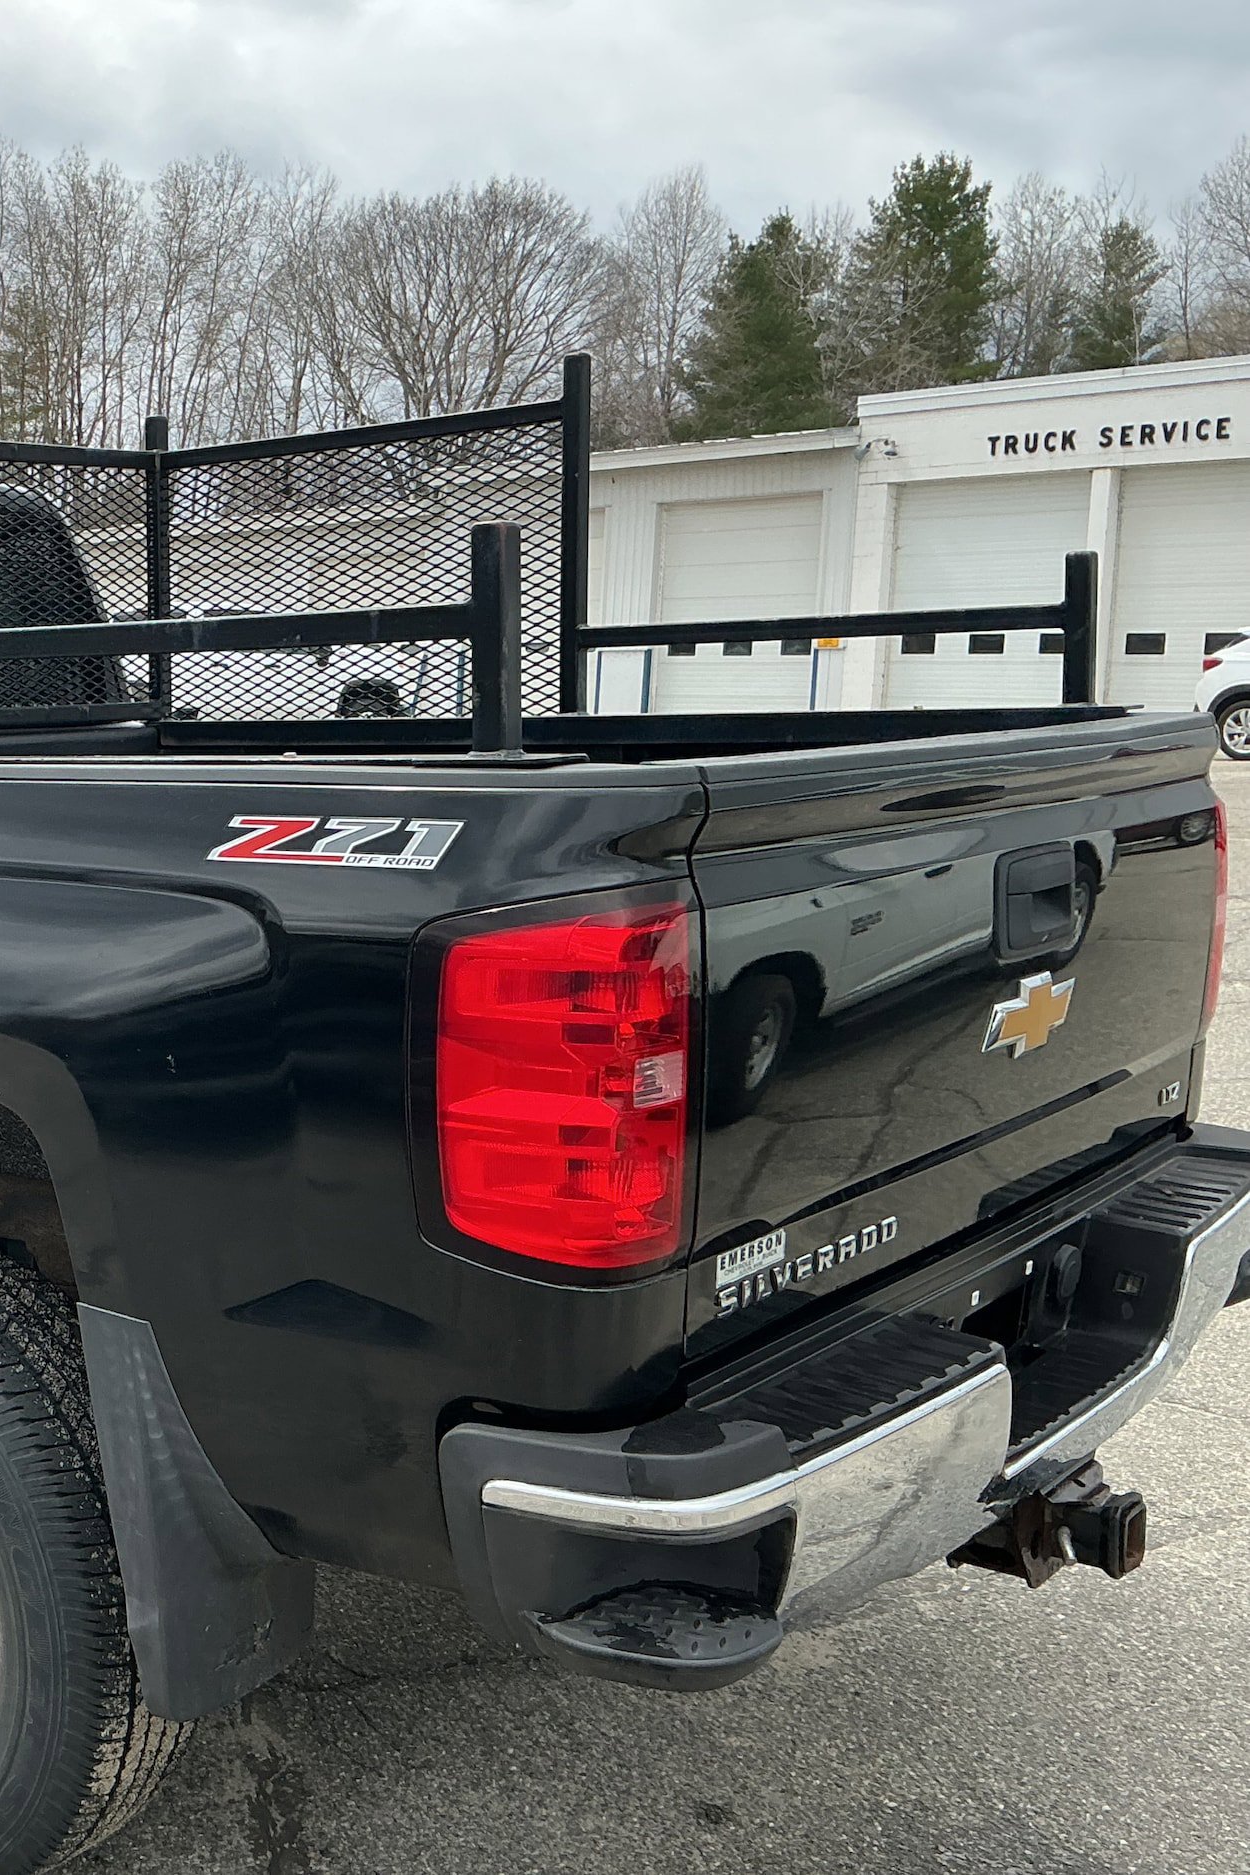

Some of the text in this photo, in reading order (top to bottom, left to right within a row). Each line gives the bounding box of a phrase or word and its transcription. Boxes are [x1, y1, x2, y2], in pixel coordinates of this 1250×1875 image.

[988, 417, 1231, 456] TRUCK SERVICE
[206, 815, 466, 870] Z71
[345, 855, 435, 868] OFF ROAD
[1160, 1080, 1180, 1105] LTZ
[715, 1215, 898, 1319] SILVERADO
[720, 1231, 783, 1271] EMERSON
